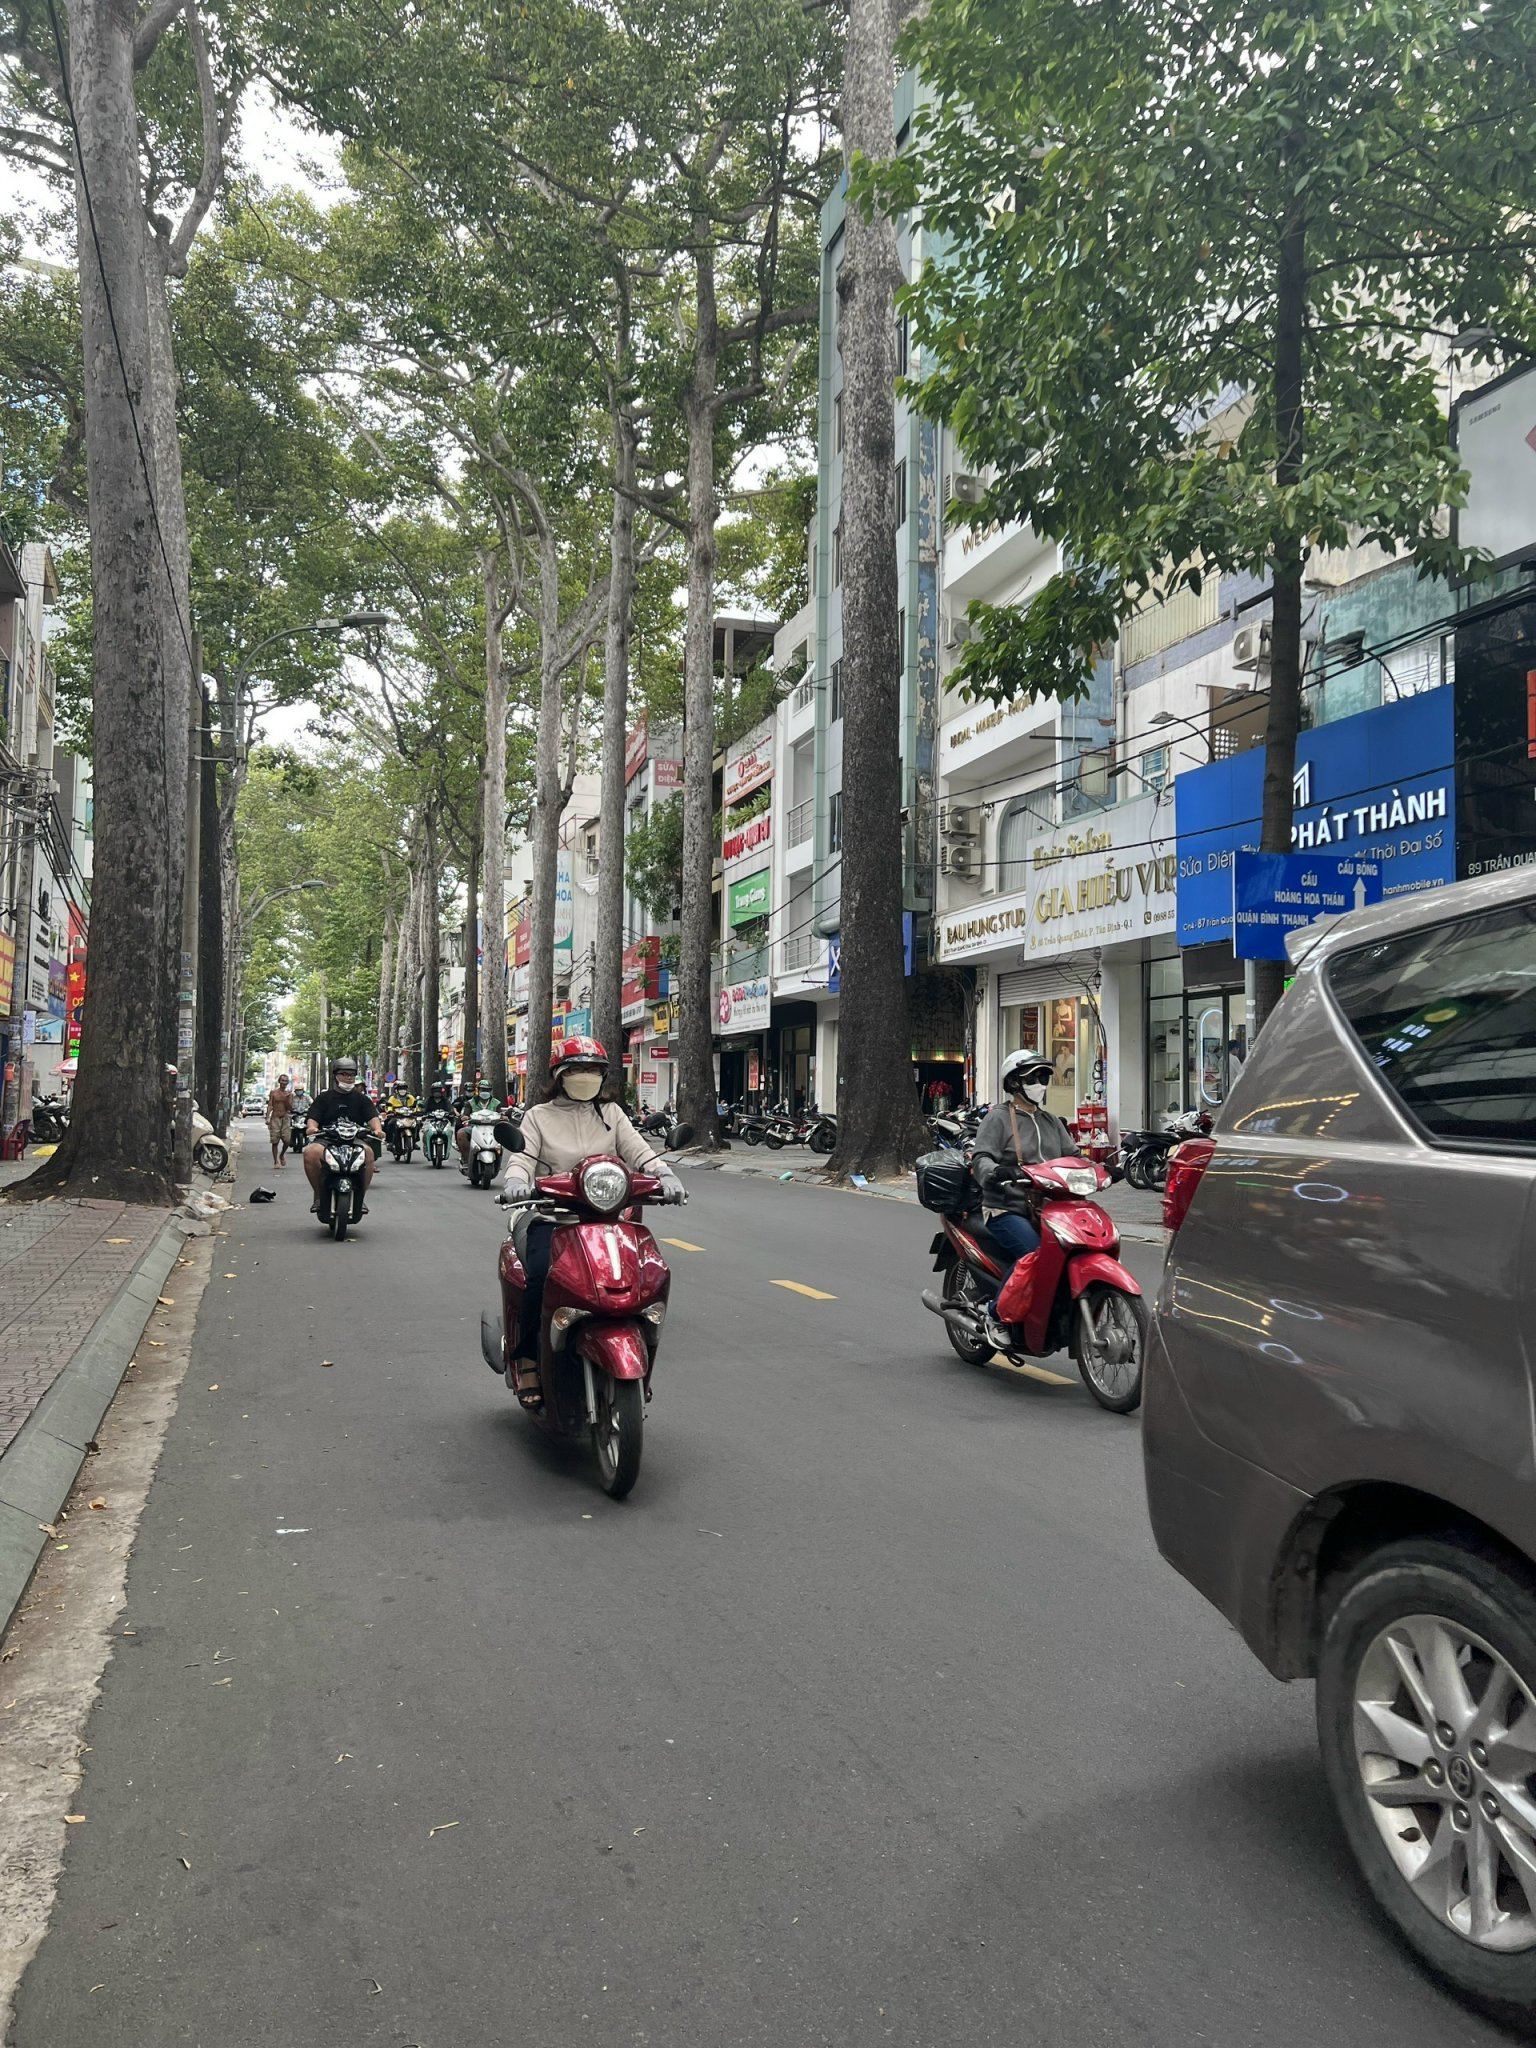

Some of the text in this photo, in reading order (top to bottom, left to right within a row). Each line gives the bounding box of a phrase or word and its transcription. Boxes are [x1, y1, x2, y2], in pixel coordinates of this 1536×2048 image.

[1353, 788, 1446, 835] THÀNH
[1066, 828, 1113, 859] Salon
[1400, 839, 1422, 857] Đại
[1425, 829, 1444, 850] Số
[1179, 855, 1202, 878] Sửa
[1468, 861, 1482, 875] 89
[1484, 852, 1512, 873] TRẦN
[1036, 884, 1075, 924] GIA
[1077, 857, 1133, 913] HIẾU
[1274, 888, 1345, 906] HOÀNG HOA THÁM
[947, 922, 966, 945] BAU
[967, 914, 998, 940] HUNG
[1237, 908, 1309, 928] QUẬN BÌNH THẠNH
